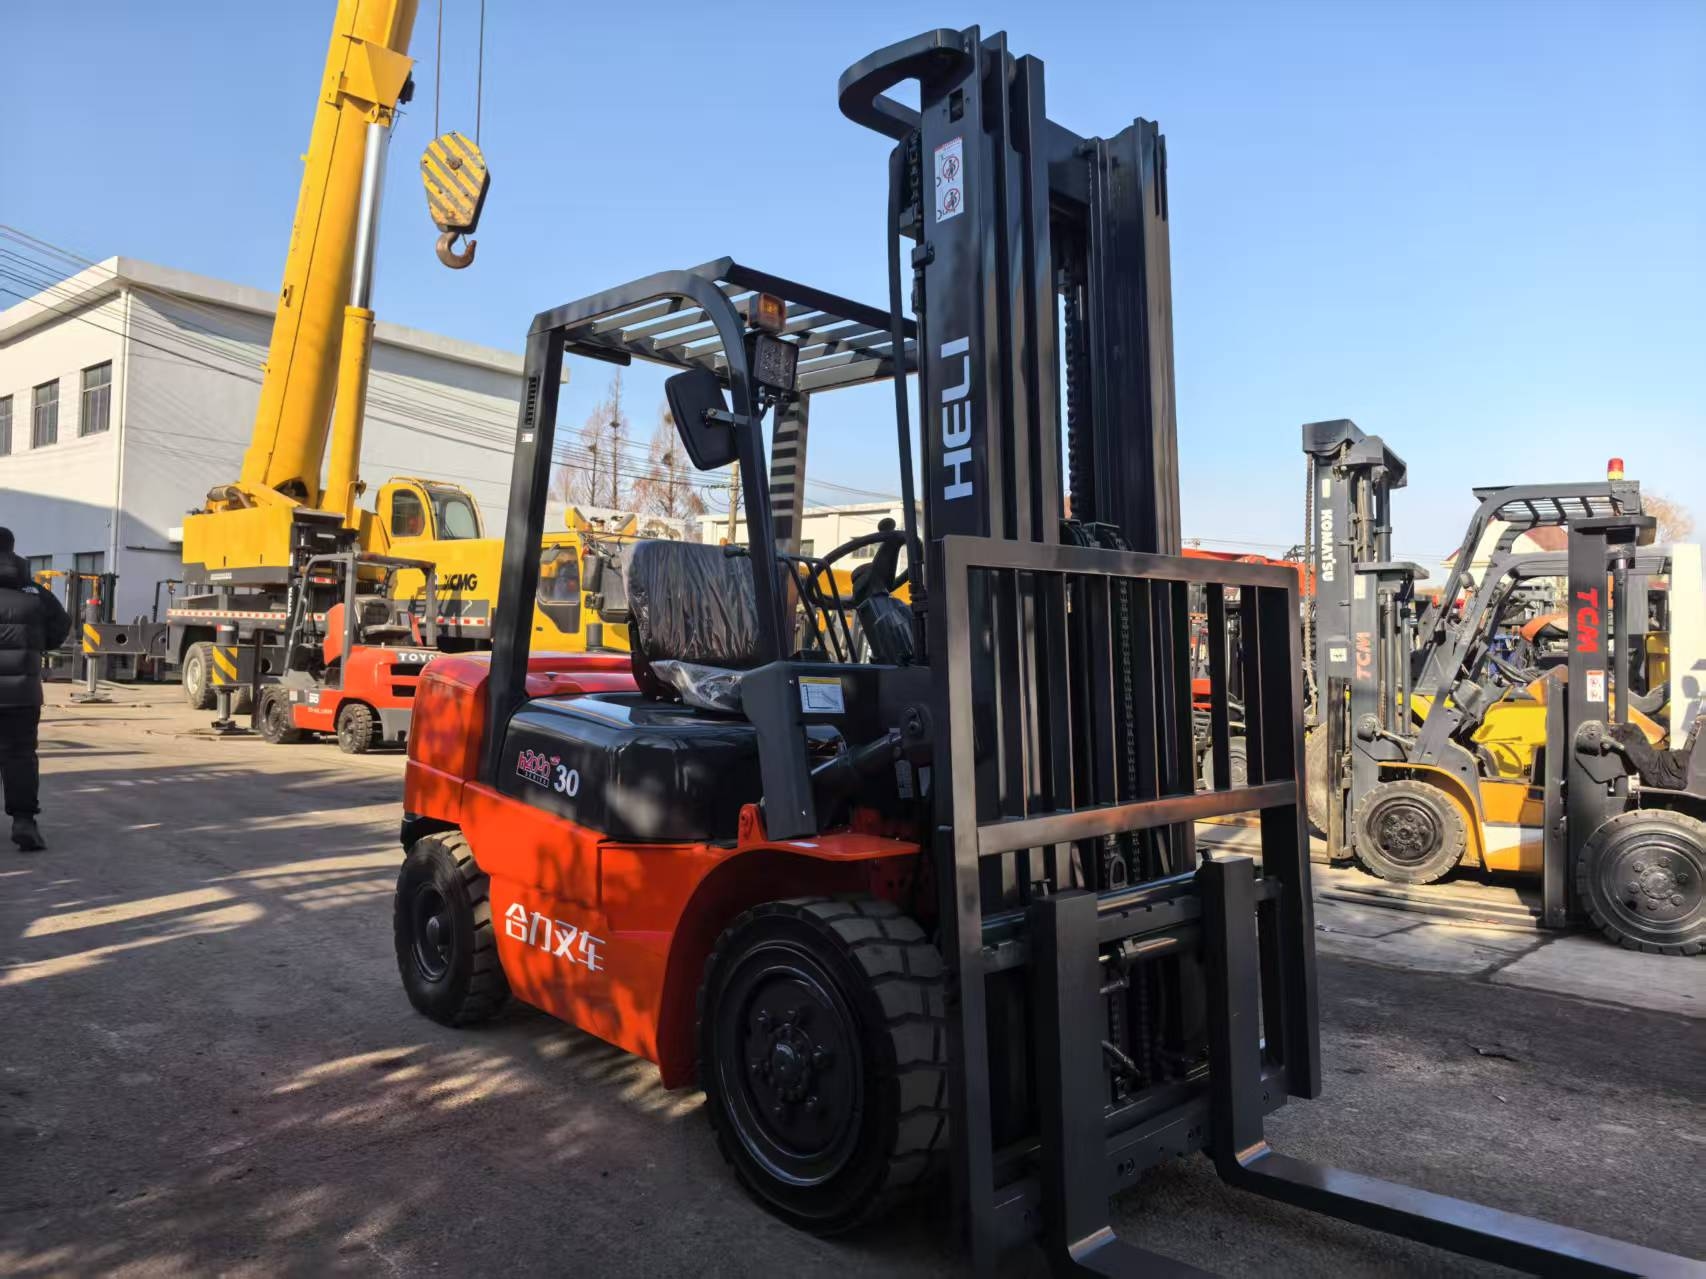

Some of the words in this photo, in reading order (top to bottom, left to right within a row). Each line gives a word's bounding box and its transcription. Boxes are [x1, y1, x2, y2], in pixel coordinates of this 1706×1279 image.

[941, 336, 973, 500] HELI
[1321, 509, 1336, 581] KOMATSU
[1576, 587, 1599, 652] TCM
[398, 652, 437, 662] TOYO
[1356, 632, 1372, 680] TCM
[554, 764, 580, 797] 30
[505, 902, 606, 971] 合力叉车
